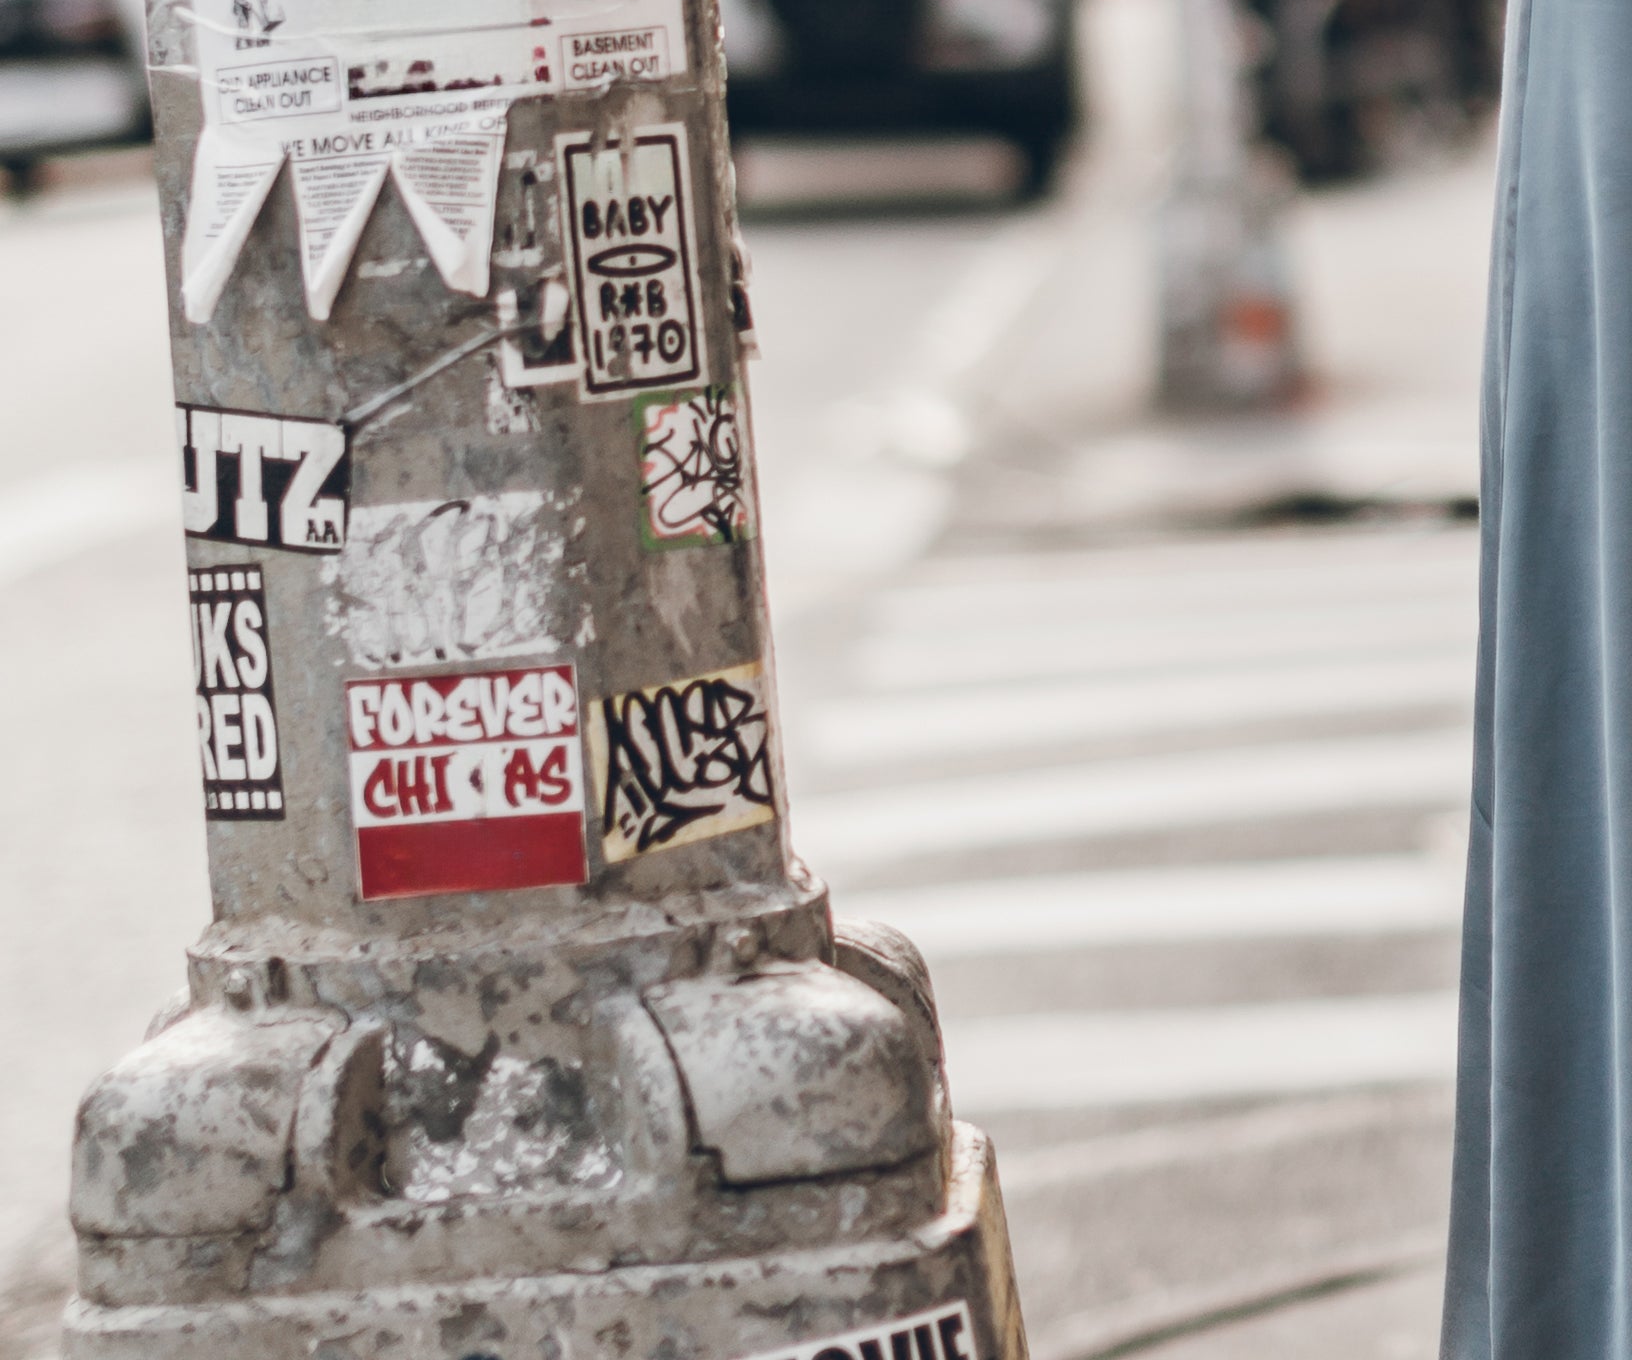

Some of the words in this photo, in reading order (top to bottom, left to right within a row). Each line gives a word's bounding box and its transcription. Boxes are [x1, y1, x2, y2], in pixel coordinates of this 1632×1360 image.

[573, 32, 655, 57] BASEMENT
[248, 66, 333, 89] APPLIANCE
[571, 59, 628, 81] CLEAN
[630, 55, 660, 75] OUT
[280, 90, 313, 109] OUT
[312, 132, 374, 155] MOVE
[582, 194, 674, 240] BABY
[191, 600, 268, 689] KS
[349, 671, 578, 748] FOREVER
[363, 745, 573, 819] CHIAS
